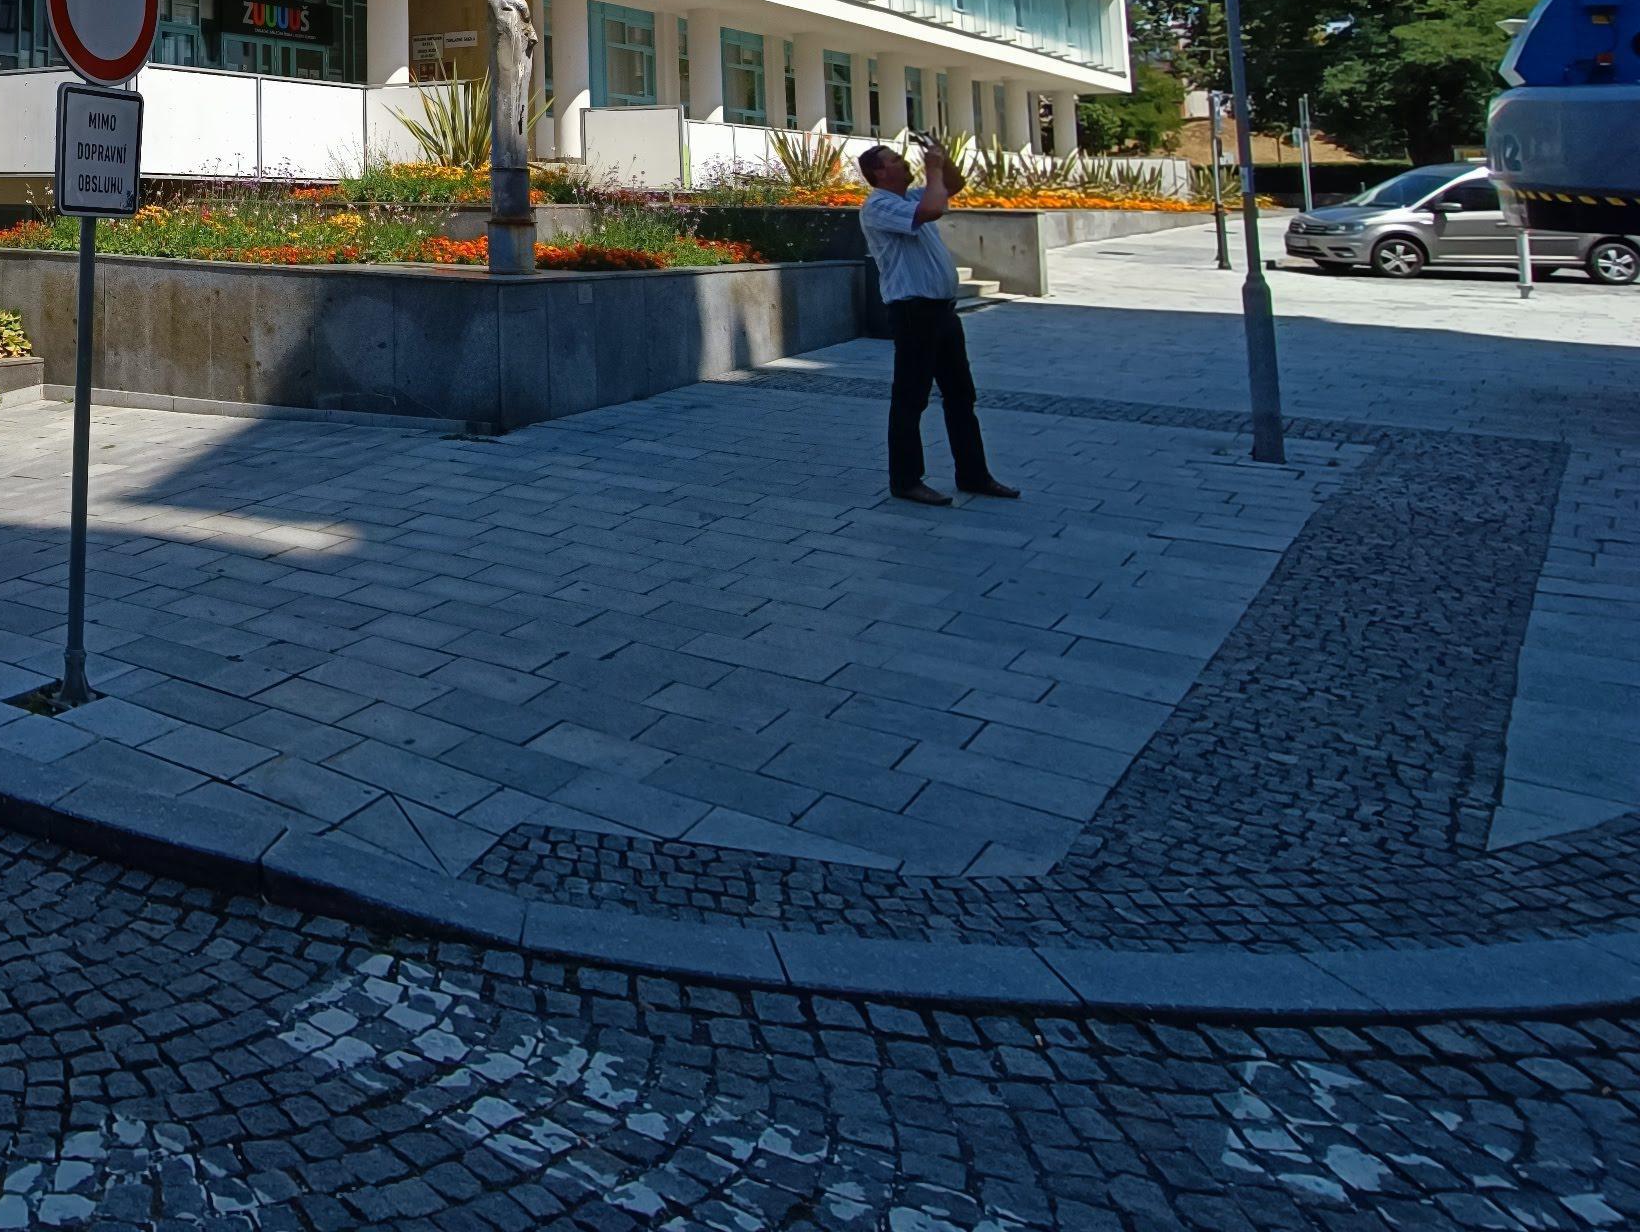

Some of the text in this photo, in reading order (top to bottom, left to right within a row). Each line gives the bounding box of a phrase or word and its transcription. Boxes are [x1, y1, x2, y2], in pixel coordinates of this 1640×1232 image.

[242, 0, 310, 32] ZUUUUŠ
[88, 111, 117, 132] MIMO
[77, 141, 127, 164] DOPRAVNÍ
[78, 173, 123, 195] OBSLUHU
